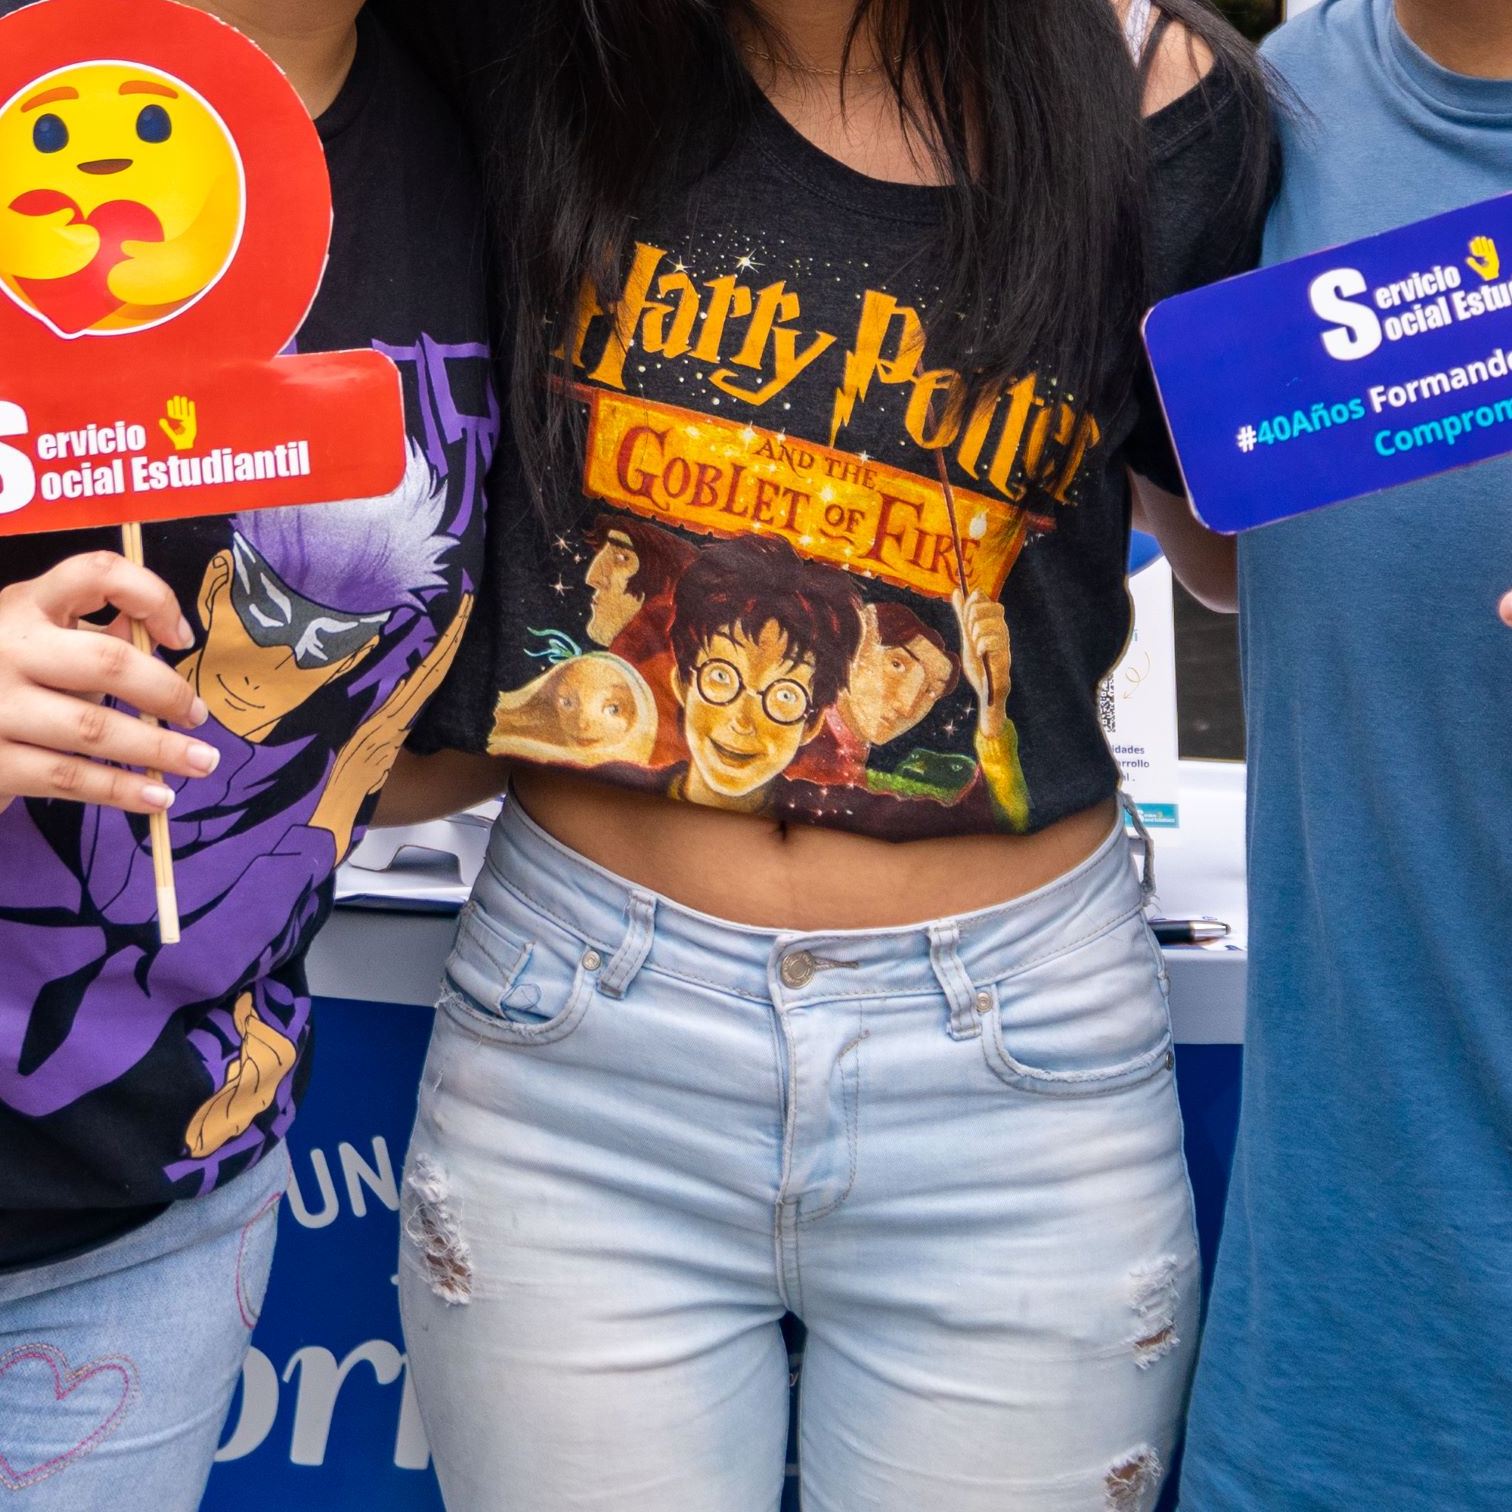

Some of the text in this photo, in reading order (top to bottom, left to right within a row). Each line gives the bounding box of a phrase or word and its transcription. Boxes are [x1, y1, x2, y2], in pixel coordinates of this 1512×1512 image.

[548, 241, 1101, 505] Harry Potter
[1235, 396, 1366, 453] #40Años
[131, 440, 311, 492] Estudiantil
[753, 438, 878, 491] AND THE
[616, 425, 811, 533] GOBLET
[820, 502, 867, 545] OF
[861, 490, 982, 590] FIRE
[288, 1135, 400, 1229] UN
